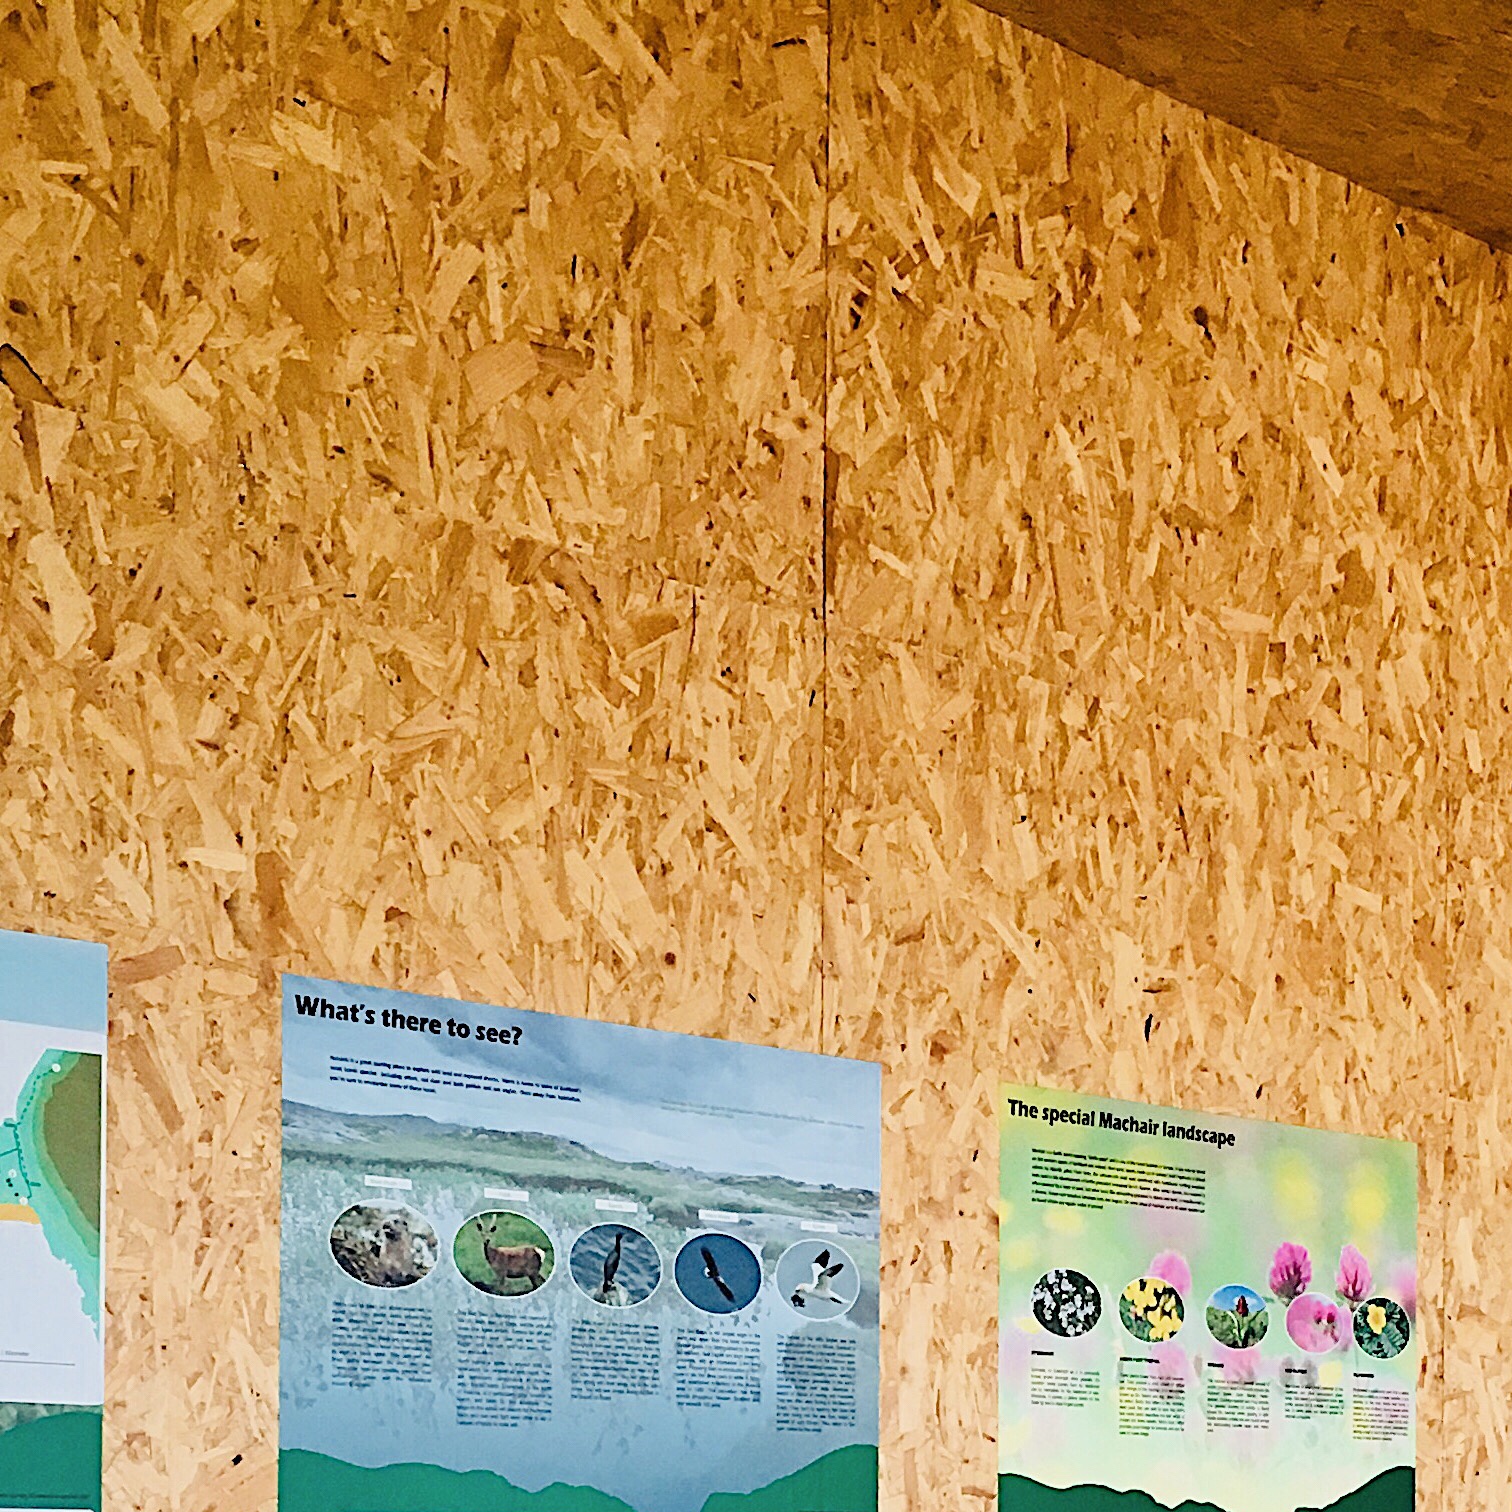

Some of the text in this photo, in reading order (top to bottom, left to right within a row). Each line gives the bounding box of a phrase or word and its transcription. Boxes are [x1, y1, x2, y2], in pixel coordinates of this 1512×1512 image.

[294, 994, 523, 1046] What's there to see?
[1007, 1098, 1236, 1149] The special Machair landscape
